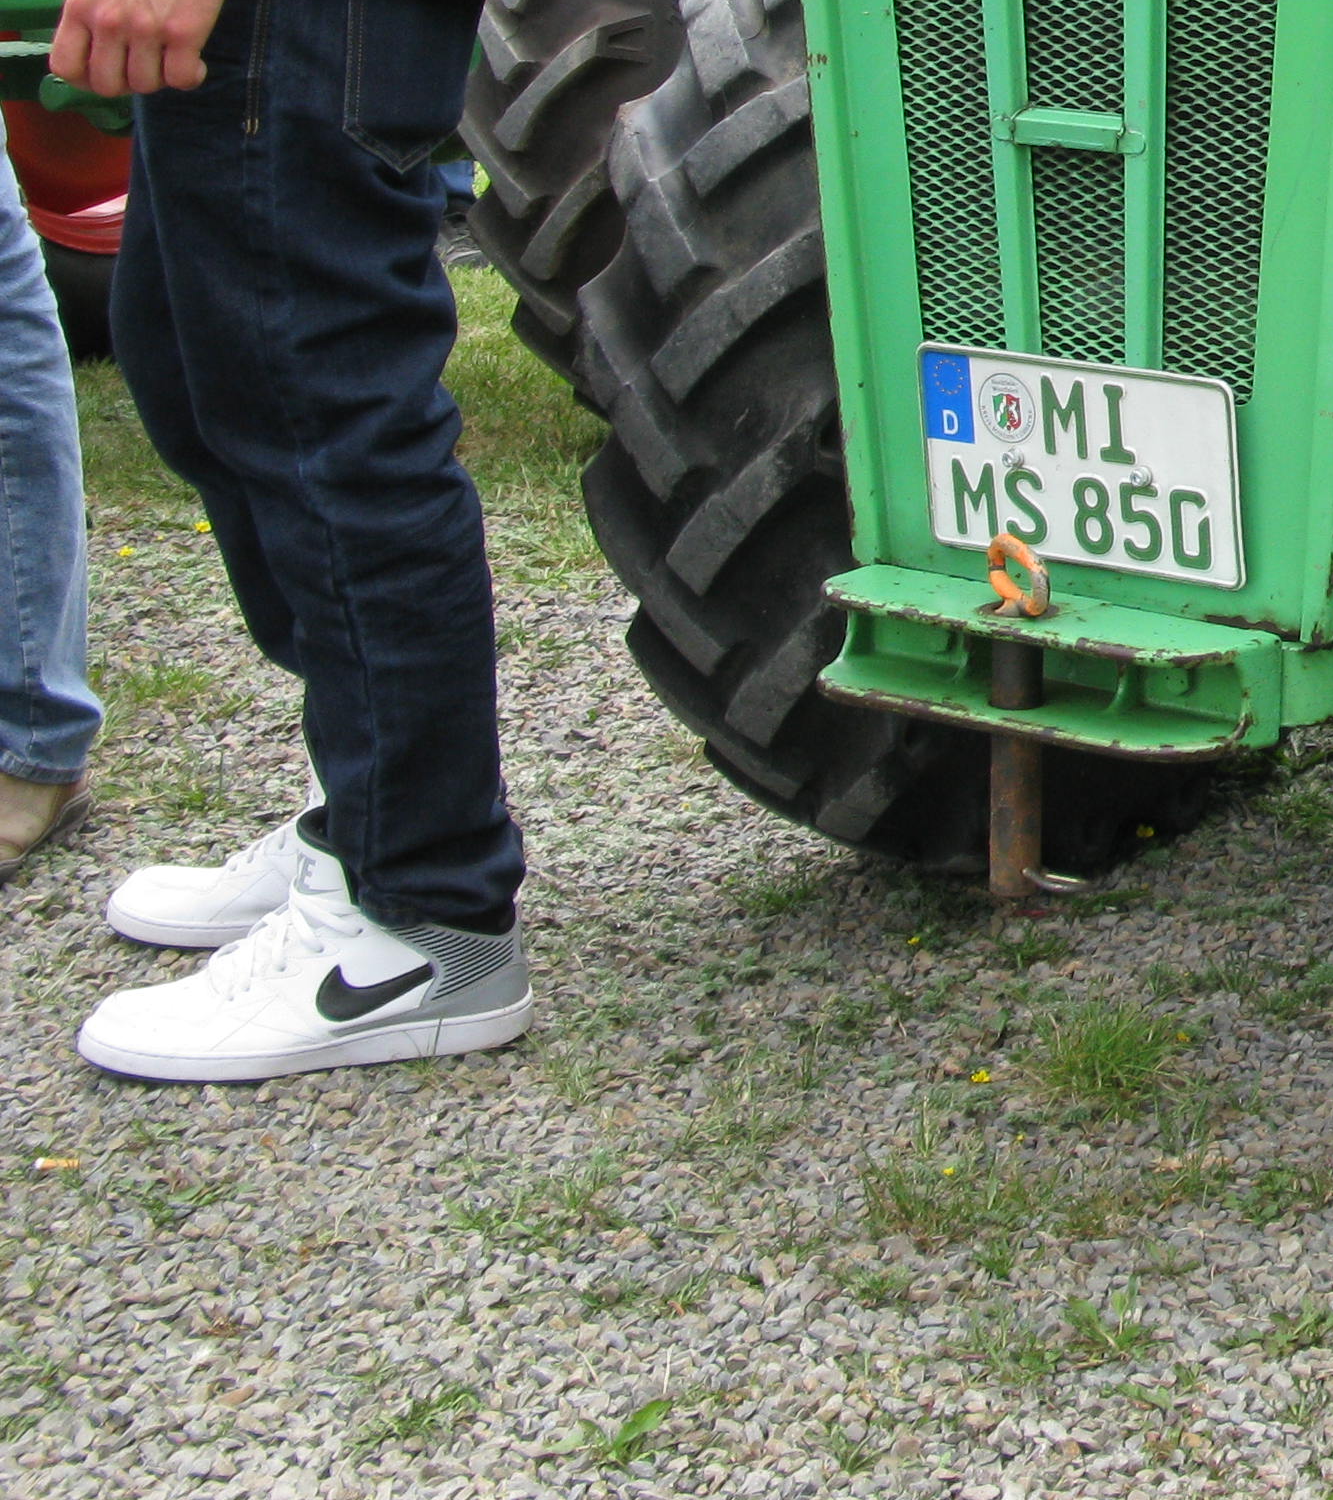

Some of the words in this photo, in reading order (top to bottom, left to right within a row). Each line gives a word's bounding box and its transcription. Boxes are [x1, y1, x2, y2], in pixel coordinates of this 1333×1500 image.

[942, 409, 959, 436] D
[1040, 374, 1136, 464] MI
[951, 457, 1048, 546] MS
[1072, 476, 1213, 570] 850
